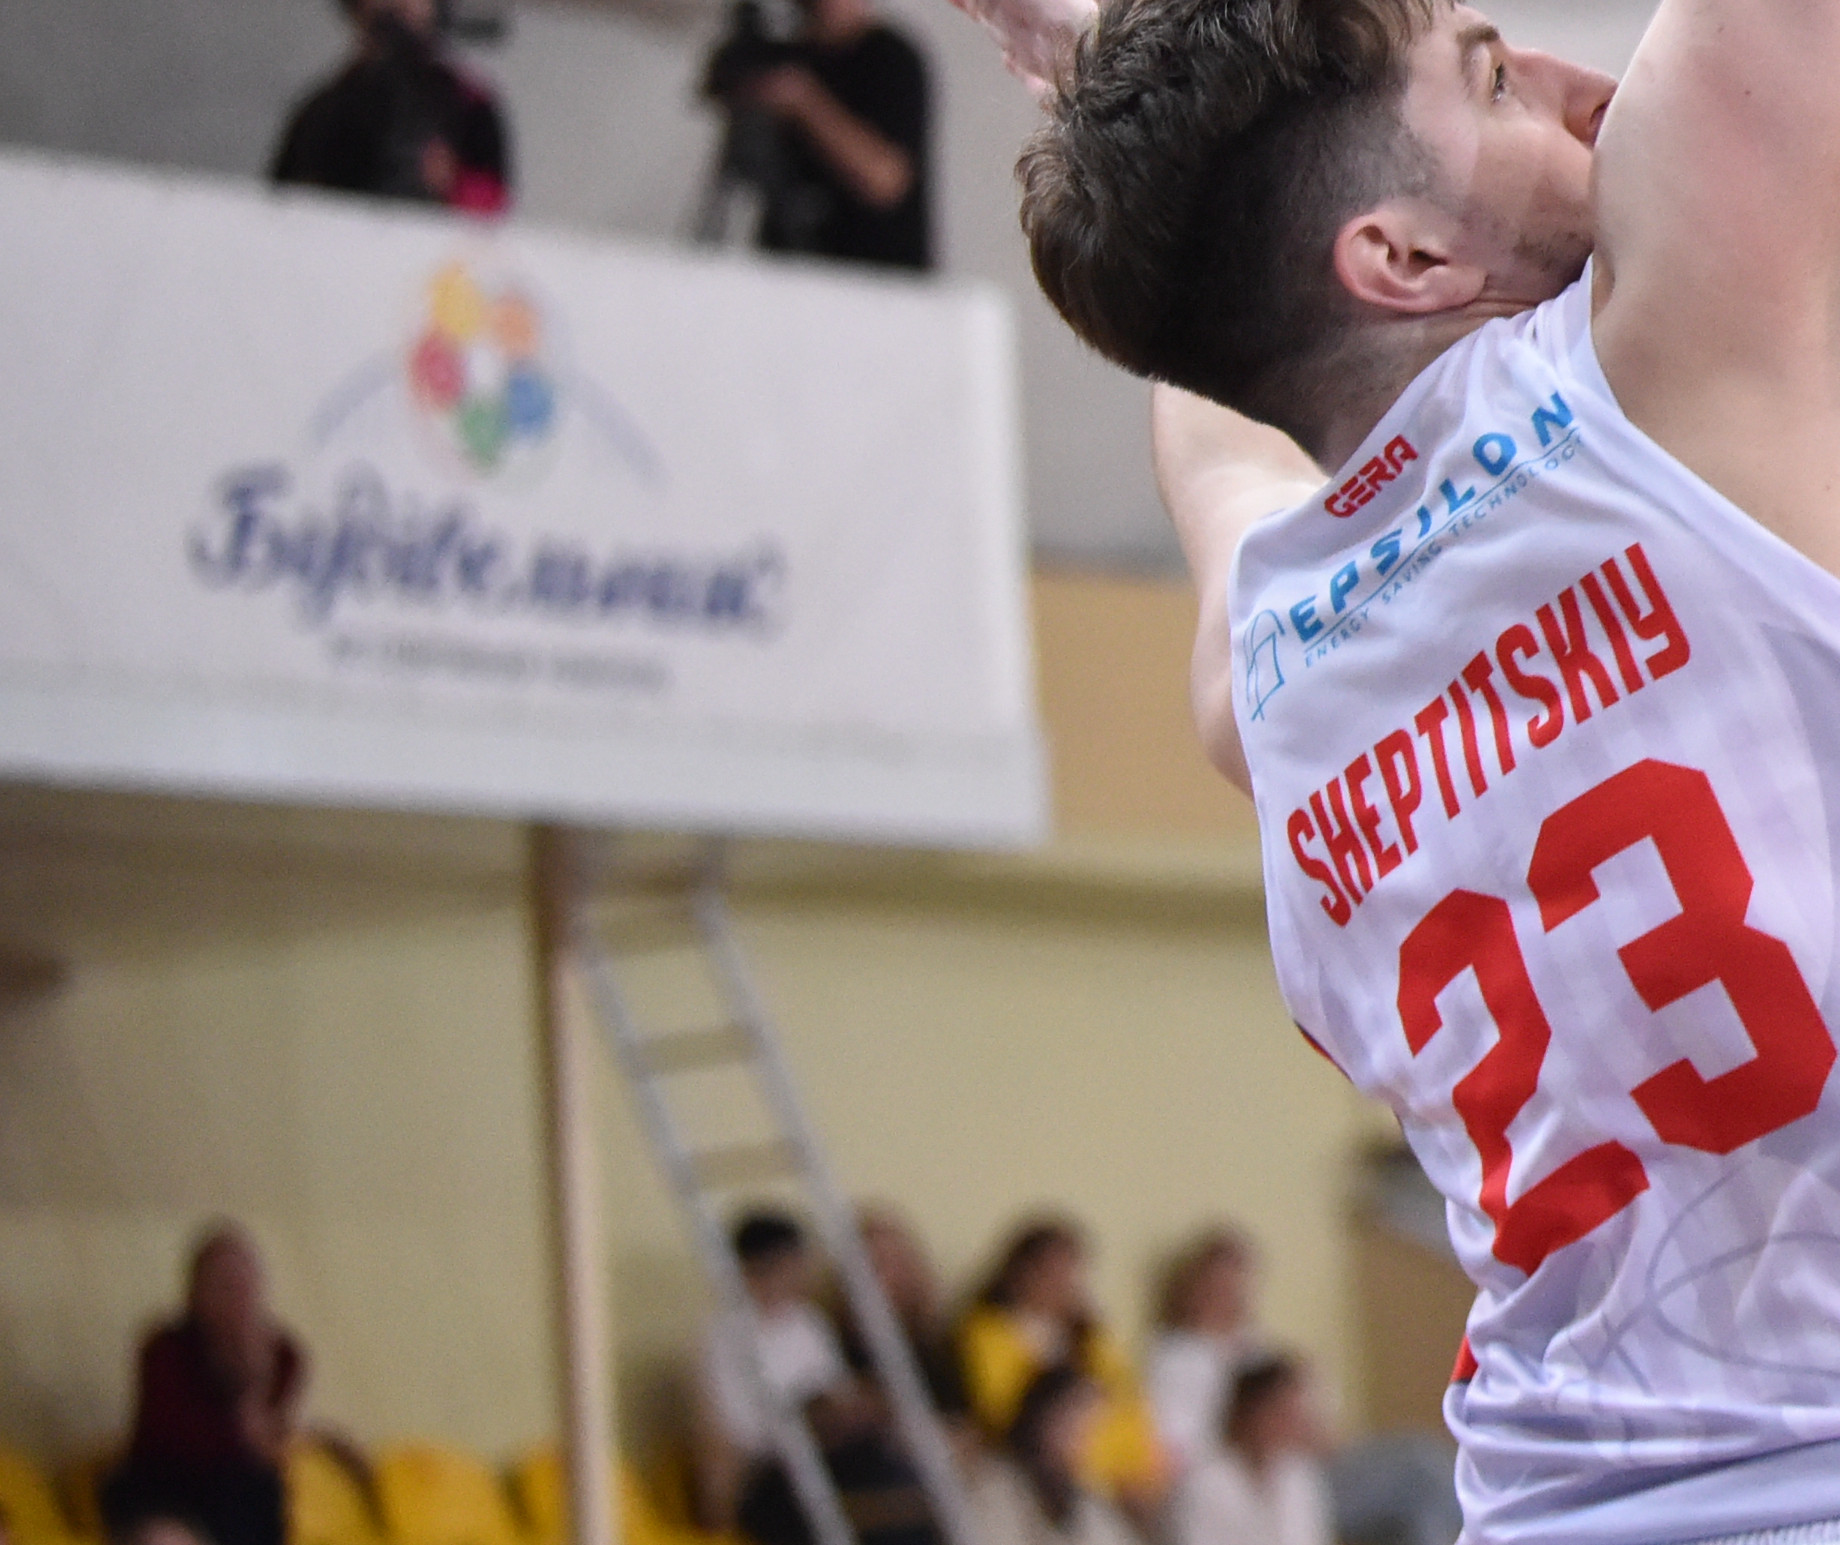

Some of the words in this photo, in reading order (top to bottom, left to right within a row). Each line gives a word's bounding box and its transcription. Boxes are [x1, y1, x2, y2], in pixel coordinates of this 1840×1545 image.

[1289, 391, 1574, 643] EPSILON
[1324, 434, 1418, 518] GERA
[1304, 607, 1371, 668] ENERGY
[1381, 538, 1443, 604] SAVING
[1286, 542, 1692, 928] SHEPTITSKIY
[1396, 756, 1839, 1279] 23
